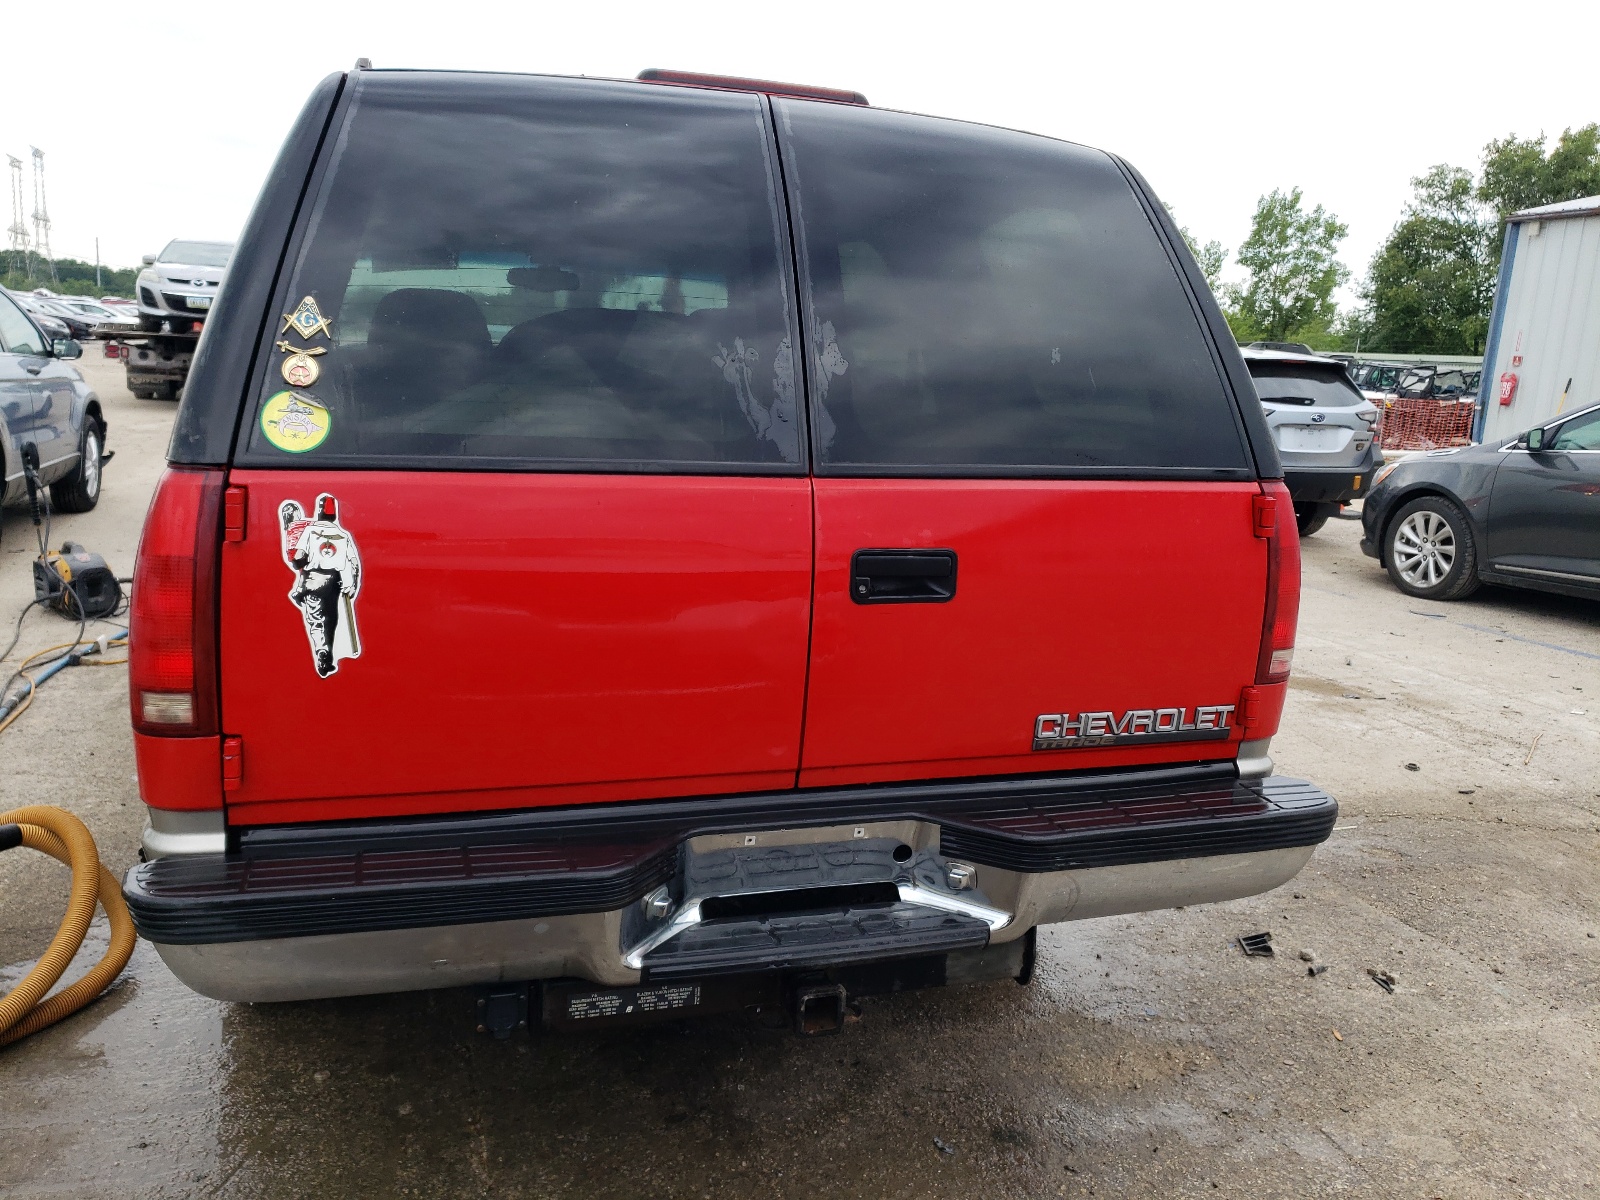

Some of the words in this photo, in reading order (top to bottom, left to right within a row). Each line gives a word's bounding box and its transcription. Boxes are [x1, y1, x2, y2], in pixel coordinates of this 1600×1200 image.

[301, 312, 314, 328] G
[282, 413, 311, 425] ANSAR
[1035, 704, 1236, 738] CHEVROLET
[1038, 737, 1116, 749] TAHOE
